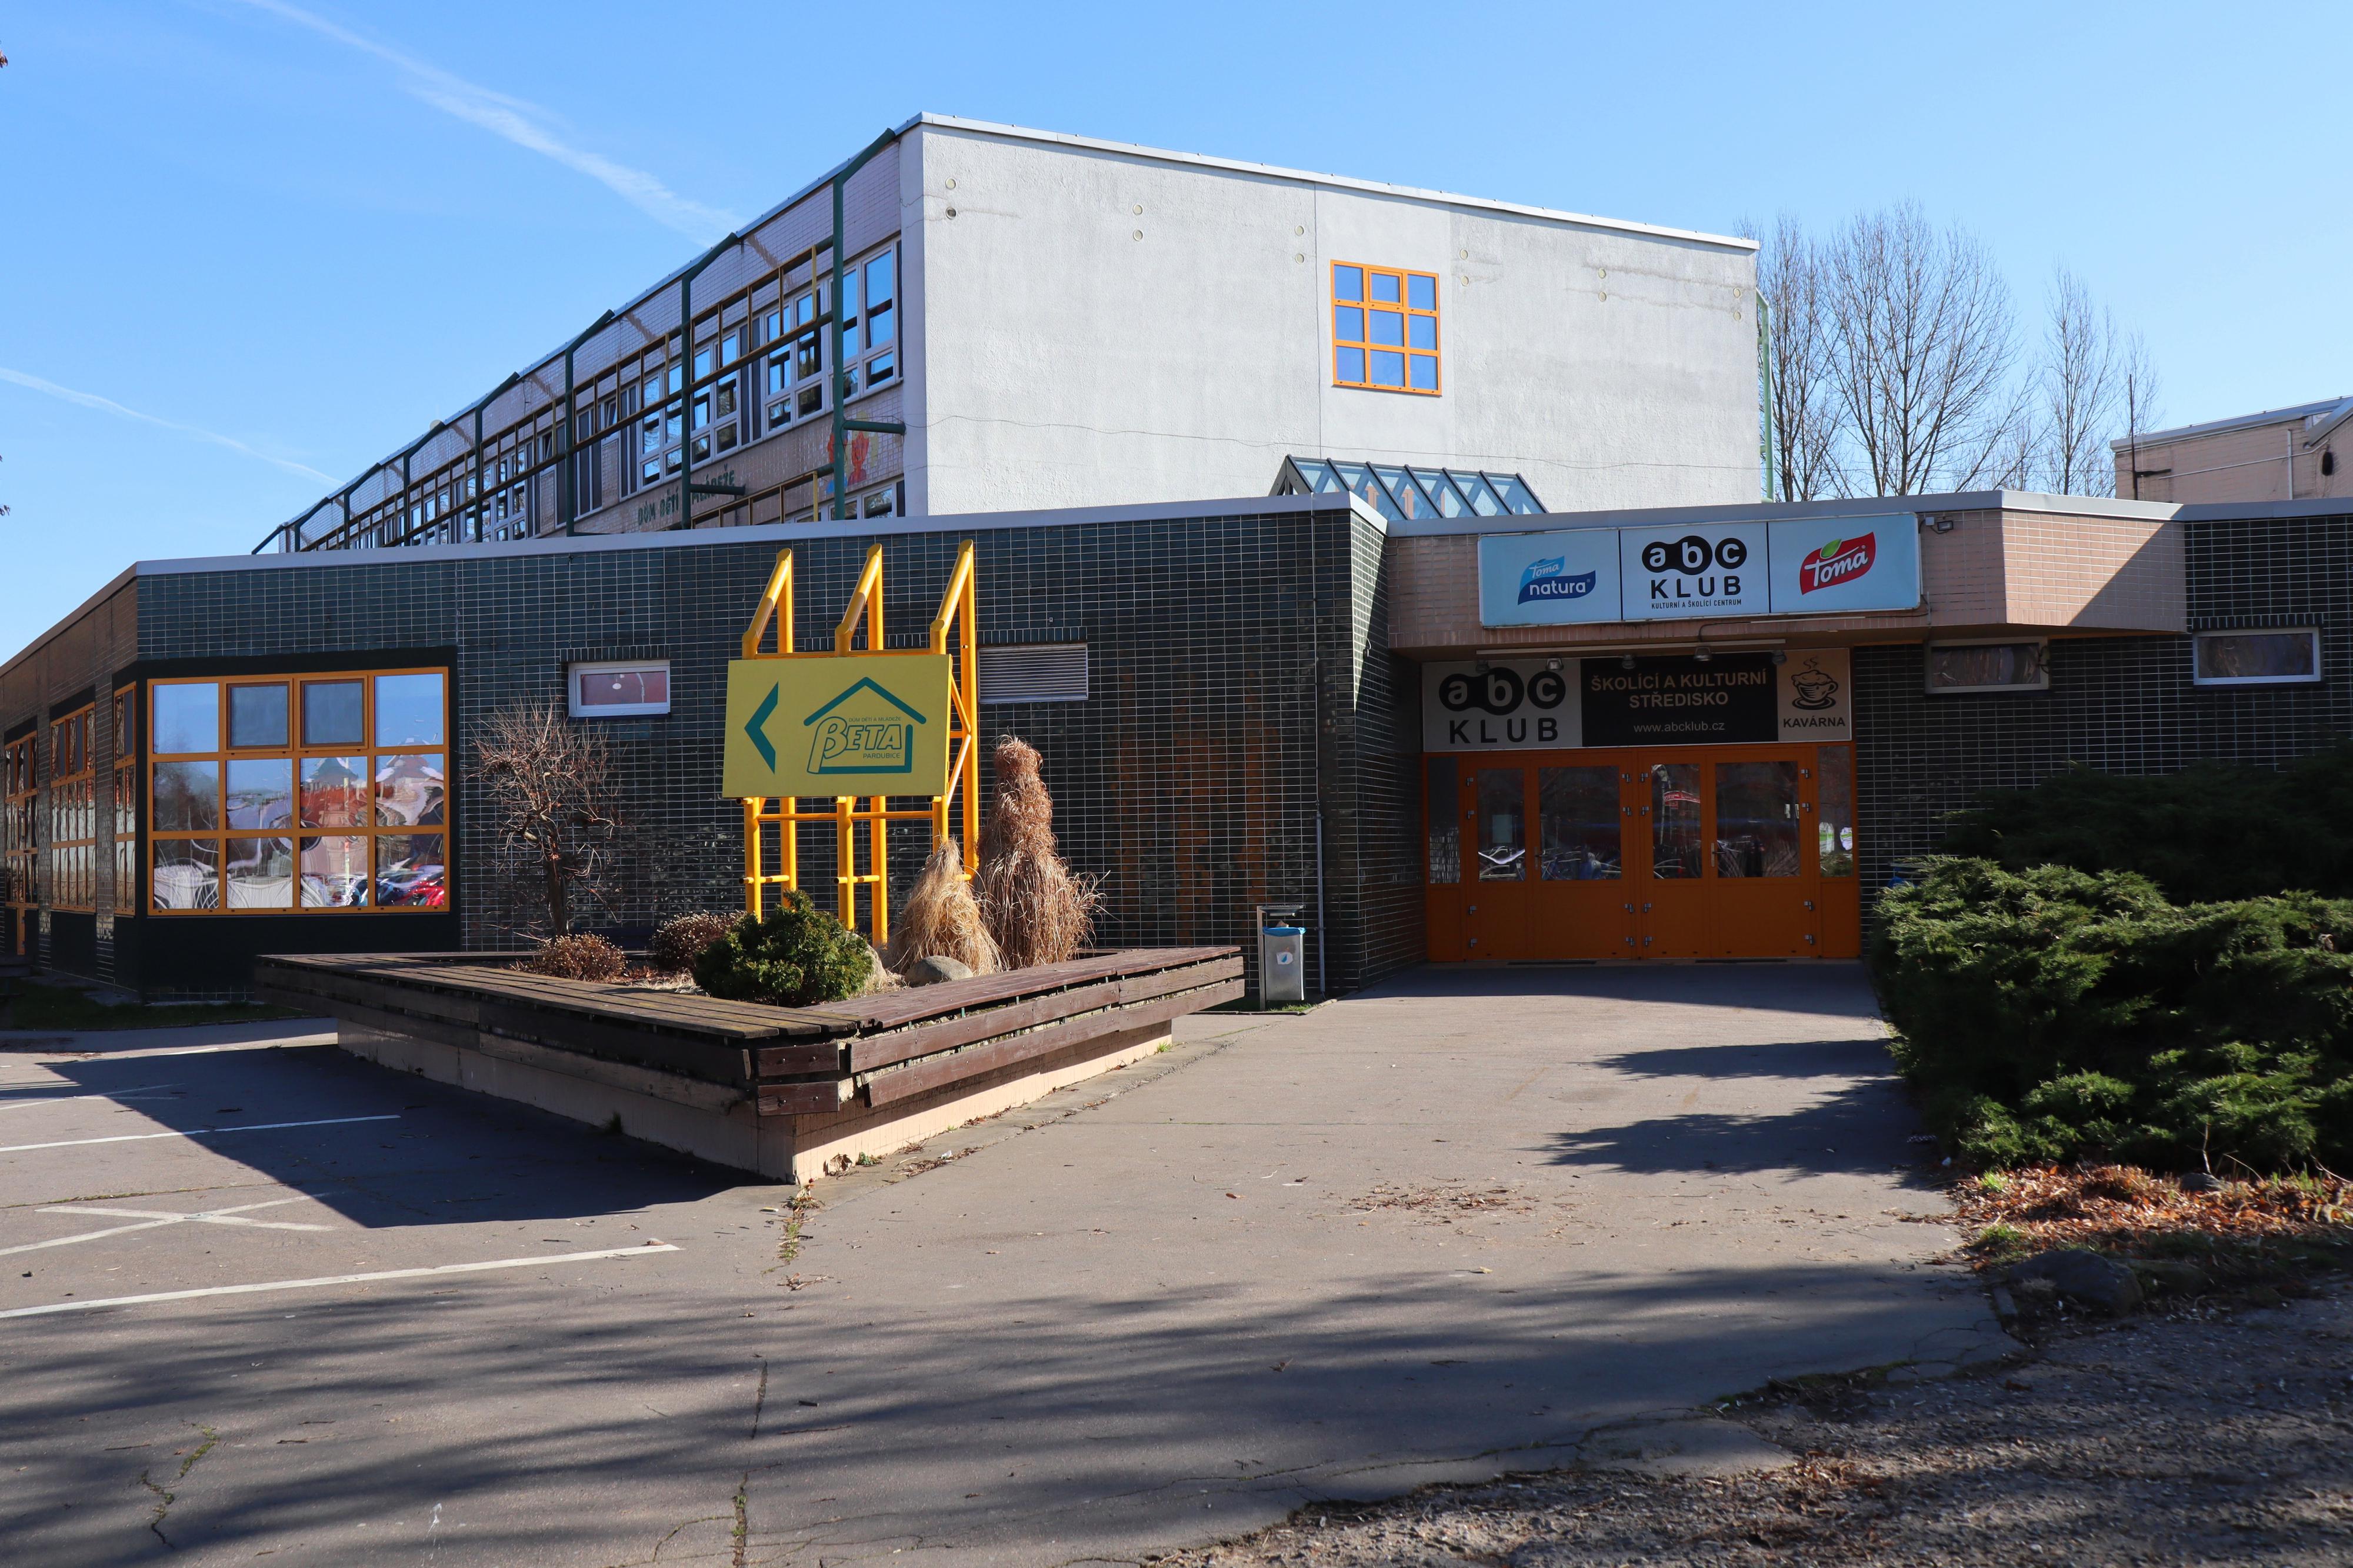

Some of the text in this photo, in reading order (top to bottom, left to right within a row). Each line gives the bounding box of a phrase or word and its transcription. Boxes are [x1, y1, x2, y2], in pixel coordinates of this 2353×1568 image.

[638, 500, 656, 525] DŮM
[660, 486, 678, 518] DĚTÍ
[1647, 539, 1743, 571] abc
[1804, 545, 1868, 587] Toma
[1529, 562, 1560, 578] Toma
[1529, 580, 1587, 596] natura
[1651, 576, 1741, 599] KLUB
[1651, 600, 1680, 609] KULTURNÍ
[1688, 599, 1711, 608] ŠKOLÍCÍ
[1445, 672, 1560, 709] abc
[1591, 668, 1767, 691] ŠKOLÍCÍ A KULTURNÍ
[1629, 691, 1729, 708] STŘEDISKO
[1449, 717, 1558, 744] KLUB
[1634, 721, 1725, 732] www.abcklub.cz
[1783, 715, 1846, 728] KAVÁRNA
